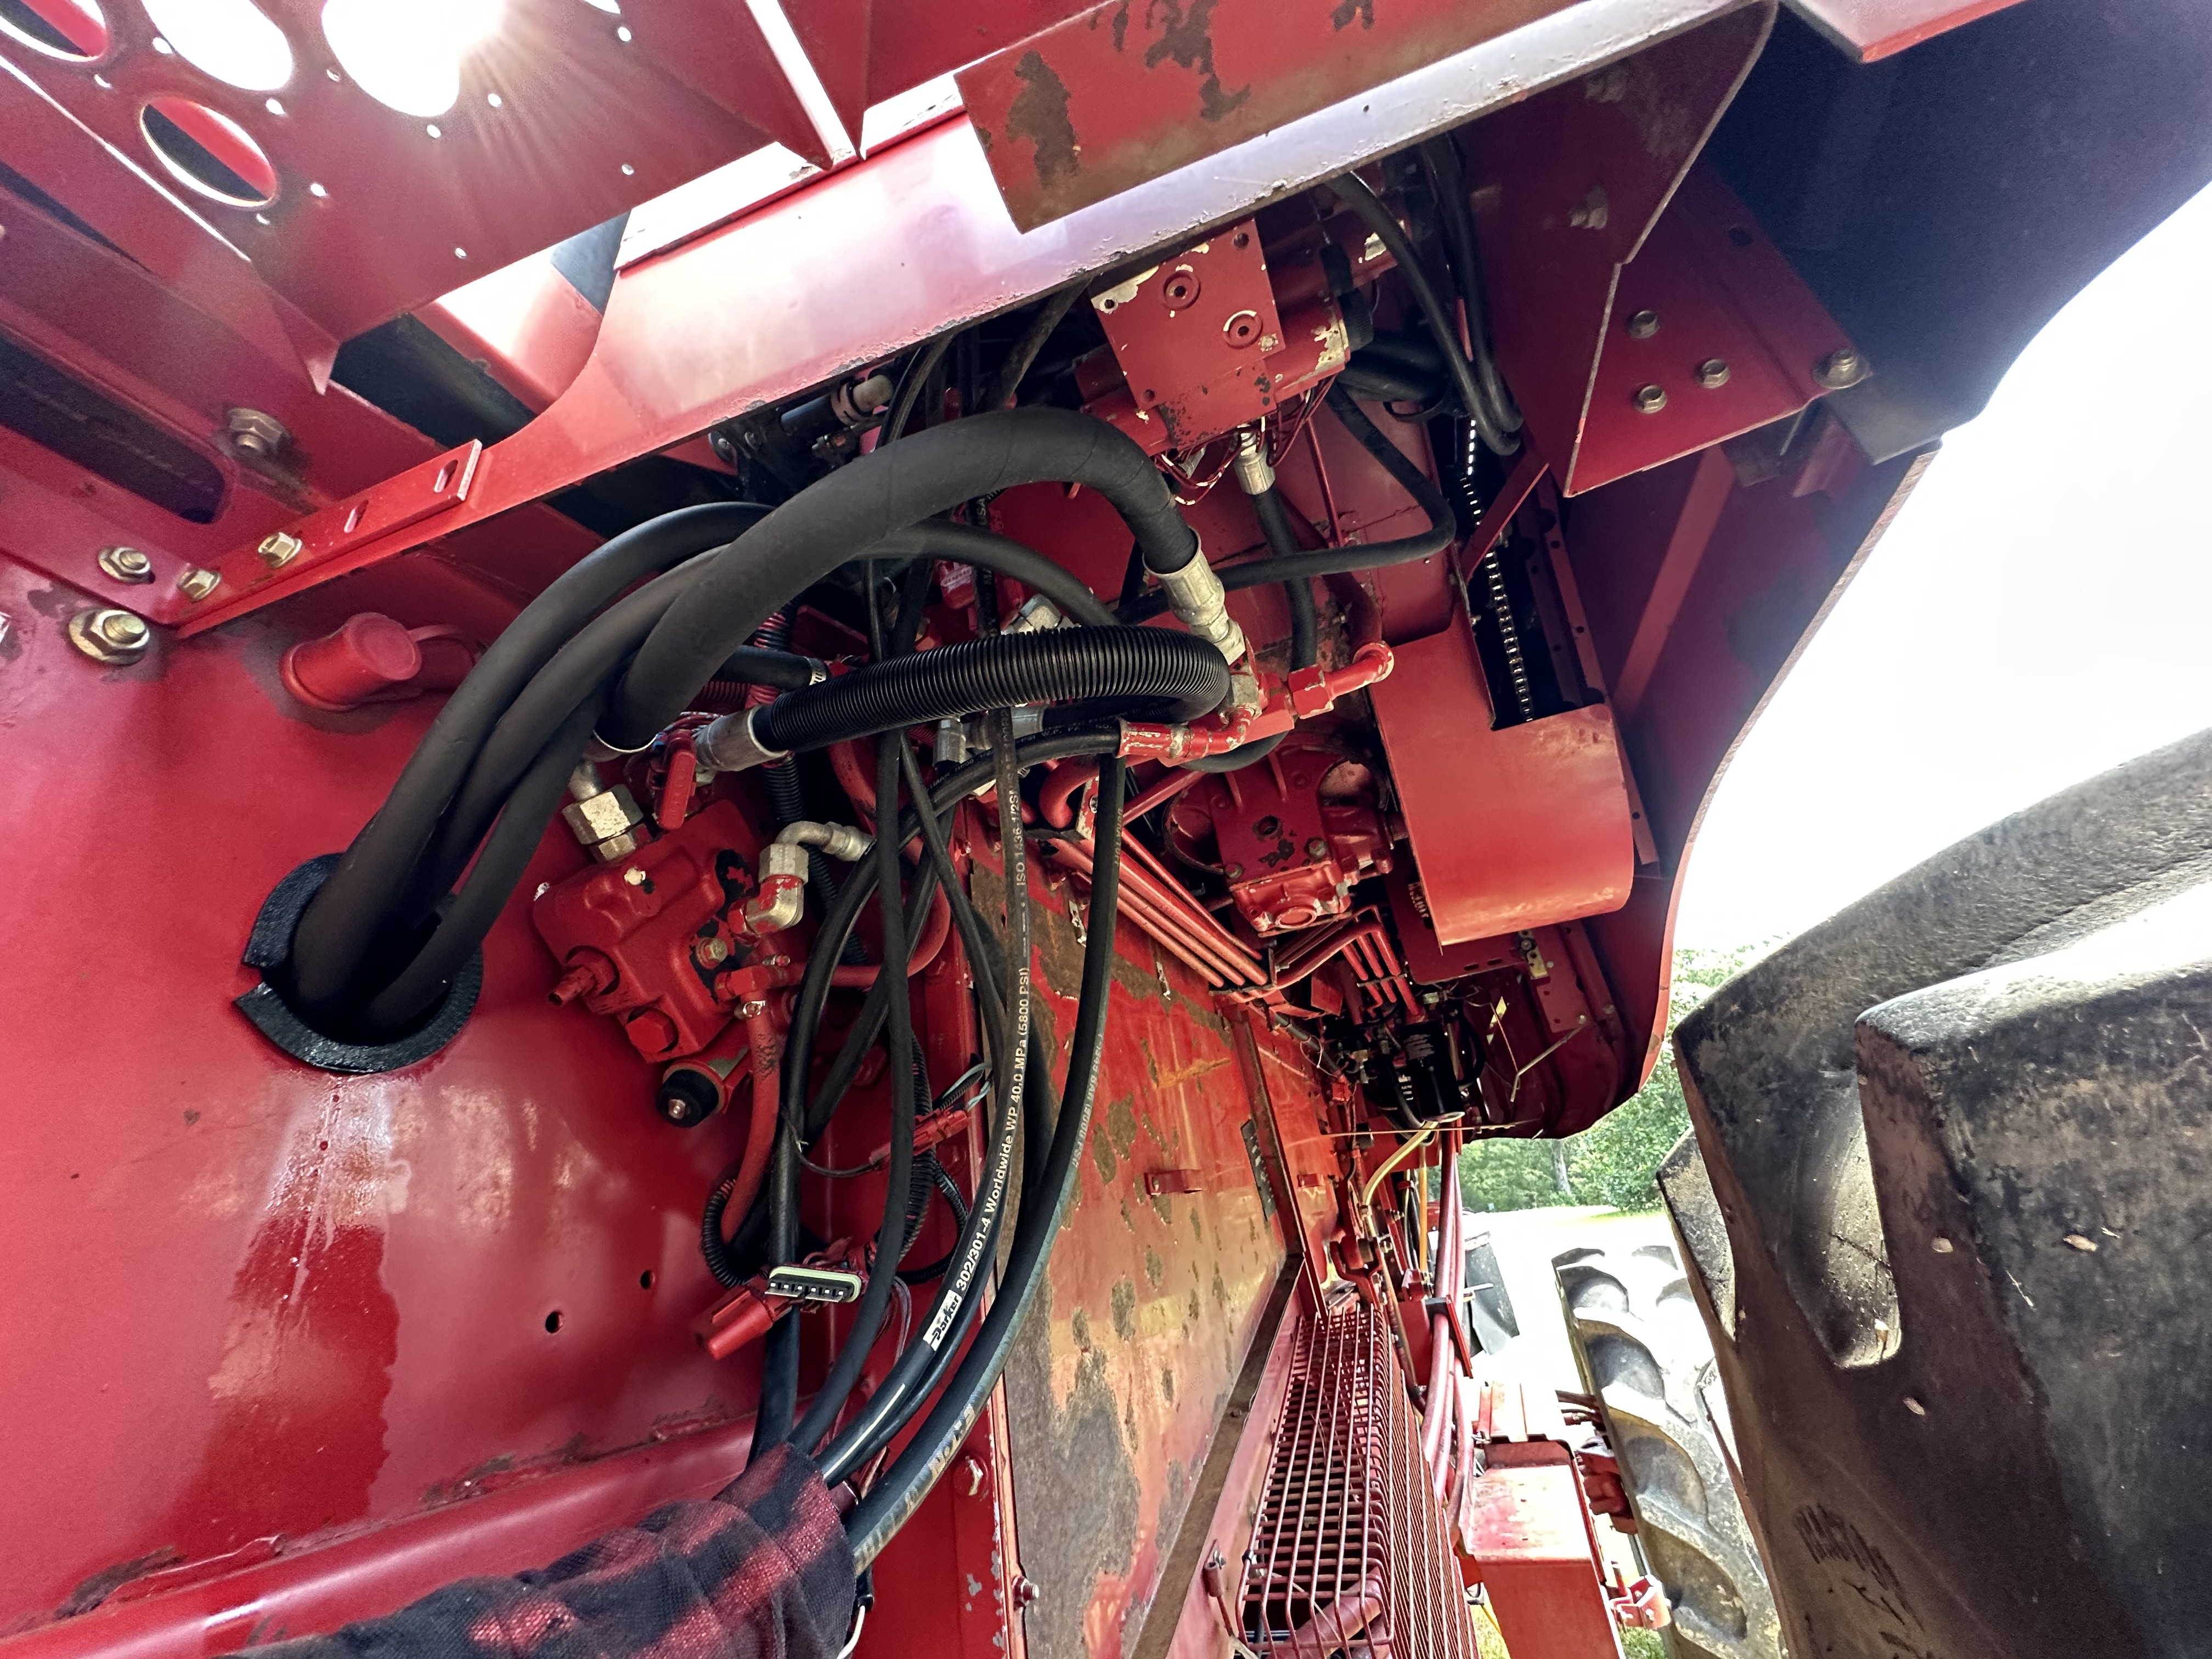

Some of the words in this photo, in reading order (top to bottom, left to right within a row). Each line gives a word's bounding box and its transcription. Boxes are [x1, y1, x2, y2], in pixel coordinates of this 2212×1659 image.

[1015, 862, 1026, 886] ISO
[1018, 967, 1030, 995] PSI)
[1017, 998, 1029, 1036] (5800
[1014, 1039, 1027, 1070] MPa
[1087, 1074, 1098, 1101] BAR
[1006, 1107, 1018, 1131] WP
[1079, 1103, 1092, 1138] (5000
[984, 1135, 1013, 1213] Worldwide
[956, 1217, 991, 1290] 302/301-4
[930, 1295, 959, 1343] Parker
